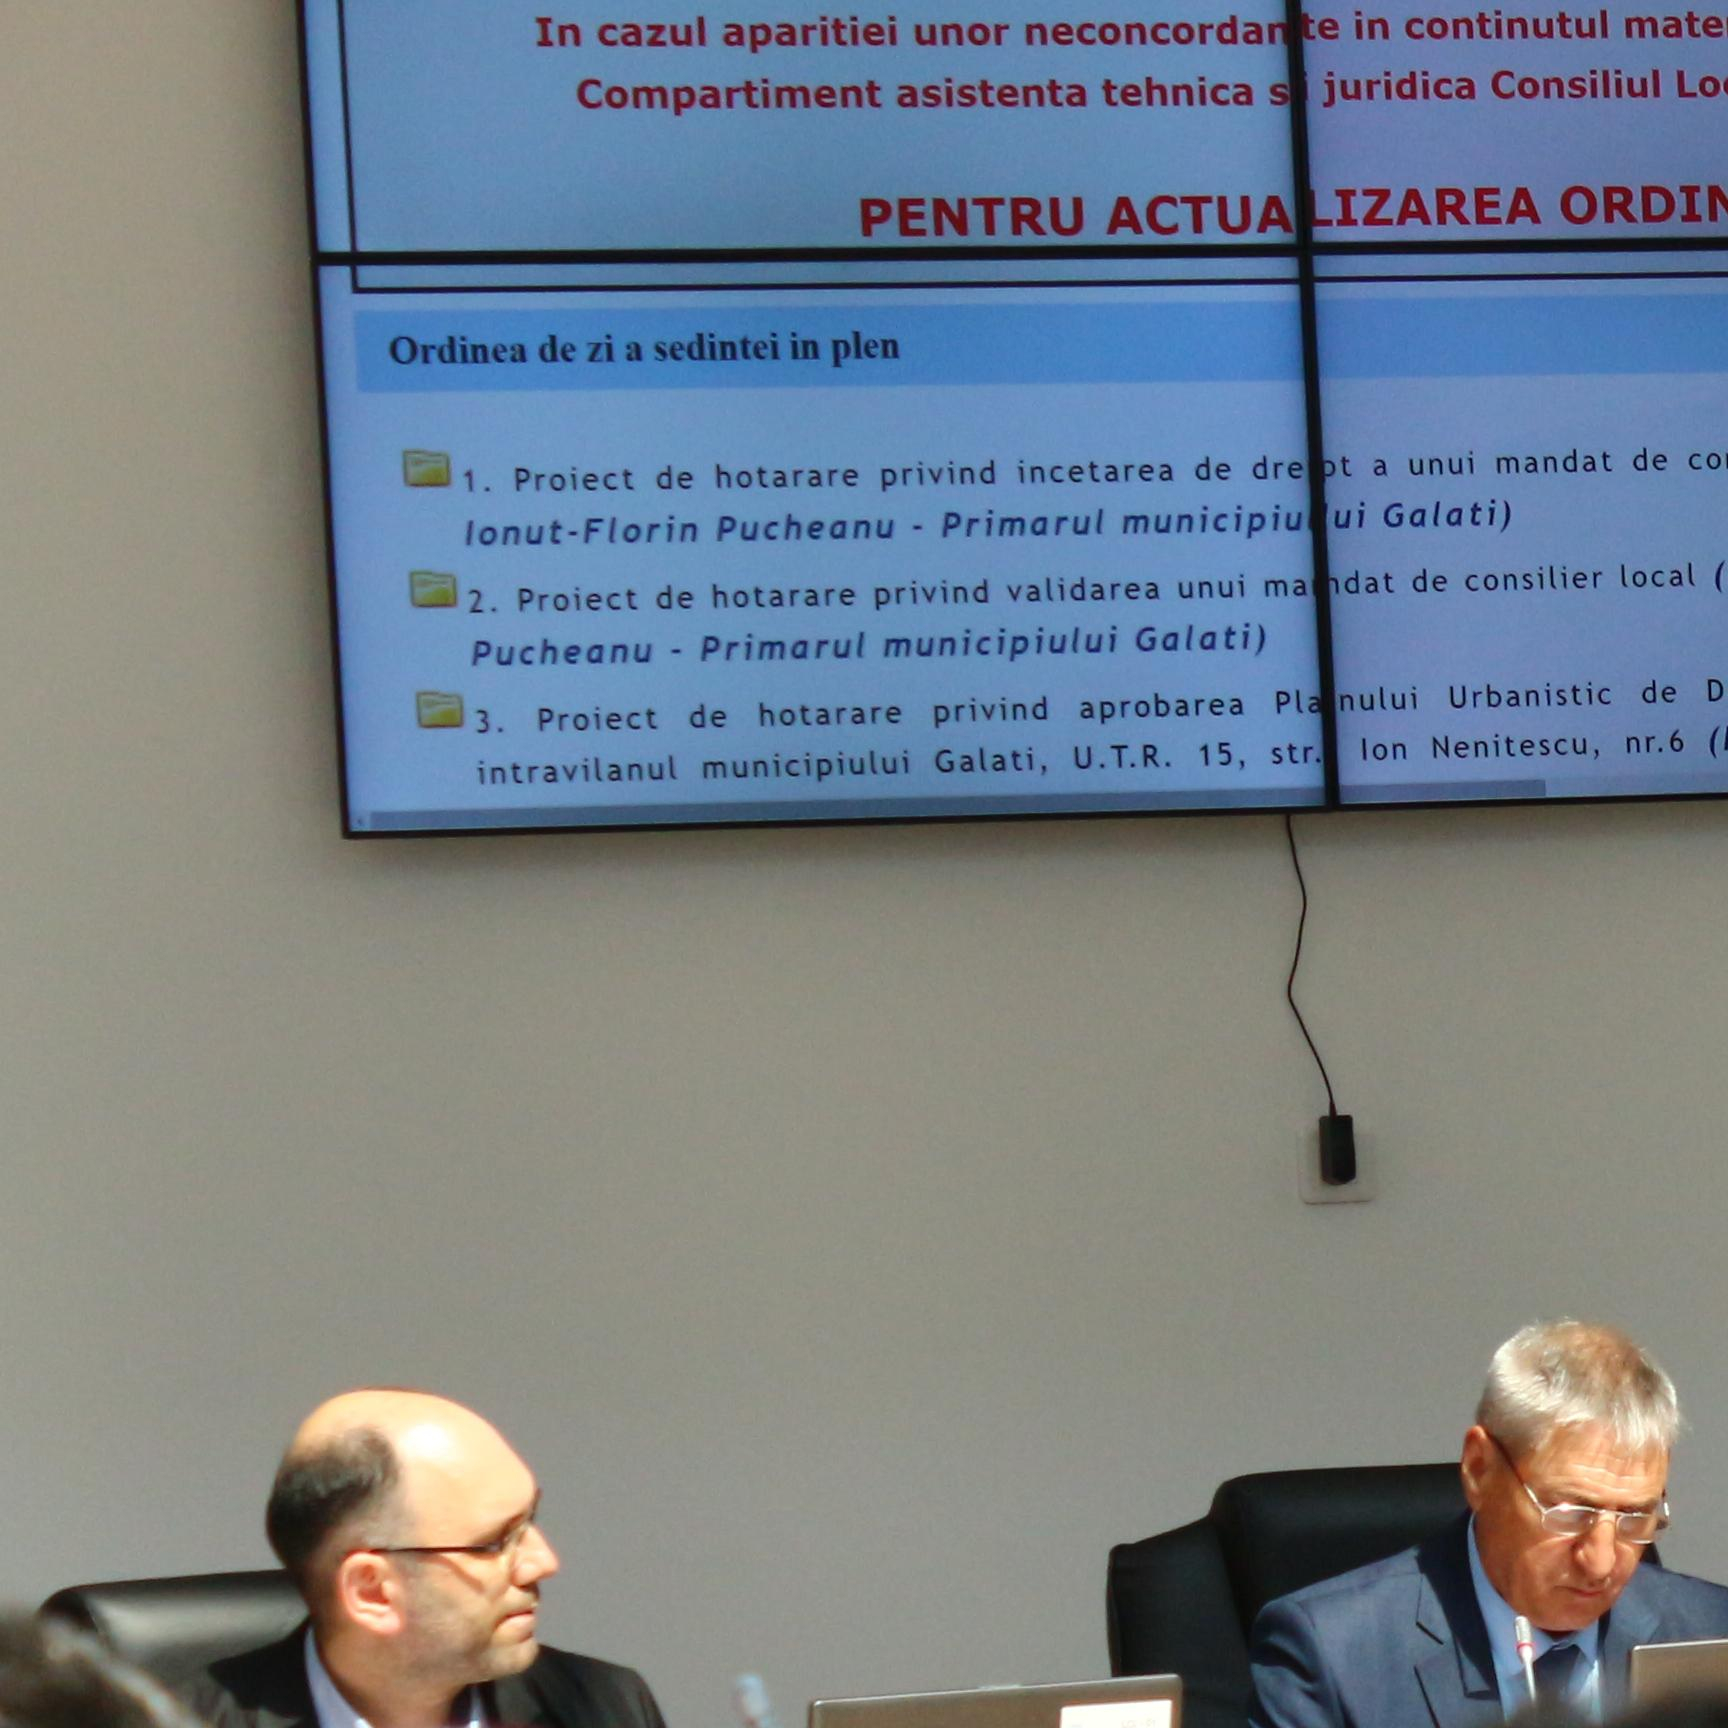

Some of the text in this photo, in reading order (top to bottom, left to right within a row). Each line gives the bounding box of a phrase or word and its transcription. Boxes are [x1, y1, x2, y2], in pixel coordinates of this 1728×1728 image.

[535, 16, 582, 48] In
[597, 15, 707, 47] cazul
[722, 15, 898, 54] aparitiei
[914, 22, 1010, 46] unor
[1025, 14, 1339, 46] neconcordante
[1354, 10, 1389, 40] in
[1405, 9, 1608, 40] continutul
[576, 78, 883, 117] Compartiment
[896, 77, 1088, 108] asistenta
[1101, 76, 1254, 107] tehnica
[1323, 70, 1476, 108] juridica
[1491, 69, 1661, 100] Consiliul
[860, 196, 1084, 237] PENTRU
[1107, 186, 1541, 235] ACTUALIZAREA
[389, 331, 900, 368] Ordinea de zi a sedintei in plen
[464, 469, 490, 492] 1.
[515, 467, 635, 492] Proiect
[656, 465, 694, 490] de
[715, 464, 859, 489] hotarare
[881, 459, 996, 492] privind
[1017, 460, 1174, 484] incetarea
[1194, 456, 1231, 481] de
[1252, 455, 1352, 480] drept
[1373, 459, 1387, 476] a
[1409, 450, 1474, 476] unui
[1496, 448, 1612, 474] mandat
[1633, 447, 1667, 471] de
[465, 515, 698, 546] Ionut-Florin
[716, 513, 895, 542] Pucheanu
[942, 508, 1104, 538] Primarul
[1383, 499, 1511, 533] Galati)
[468, 589, 497, 613] 2.
[518, 587, 638, 612] Proiect
[656, 584, 694, 610] de
[712, 584, 856, 609] hotarare
[874, 578, 989, 611] privind
[1007, 576, 1160, 602] validarea
[1178, 574, 1245, 599] unui
[1264, 570, 1395, 597] mandat
[1412, 568, 1448, 593] de
[1465, 565, 1603, 592] consilier
[1621, 562, 1695, 588] local
[471, 638, 653, 666] Pucheanu
[700, 632, 865, 662] Primarul
[883, 625, 1117, 662] municipiului
[1135, 622, 1266, 656] Galati)
[476, 709, 504, 734] 3.
[538, 706, 658, 732] Proiect
[689, 703, 727, 729] de
[759, 702, 902, 727] hotarare
[934, 695, 1048, 729] privind
[1080, 693, 1244, 725] aprobarea
[1276, 686, 1417, 714] Planului
[1449, 681, 1611, 709] Urbanistic
[1641, 679, 1677, 704] de
[477, 755, 677, 785] intravilanul
[703, 750, 909, 782] municipiului
[934, 747, 1047, 775] Galati,
[1074, 744, 1171, 769] U.T.R.
[1199, 742, 1245, 770] 15,
[1271, 743, 1322, 765] str.
[1362, 738, 1407, 761] Ion
[1432, 733, 1599, 760] Nenitescu,
[1626, 729, 1684, 754] nr.6
